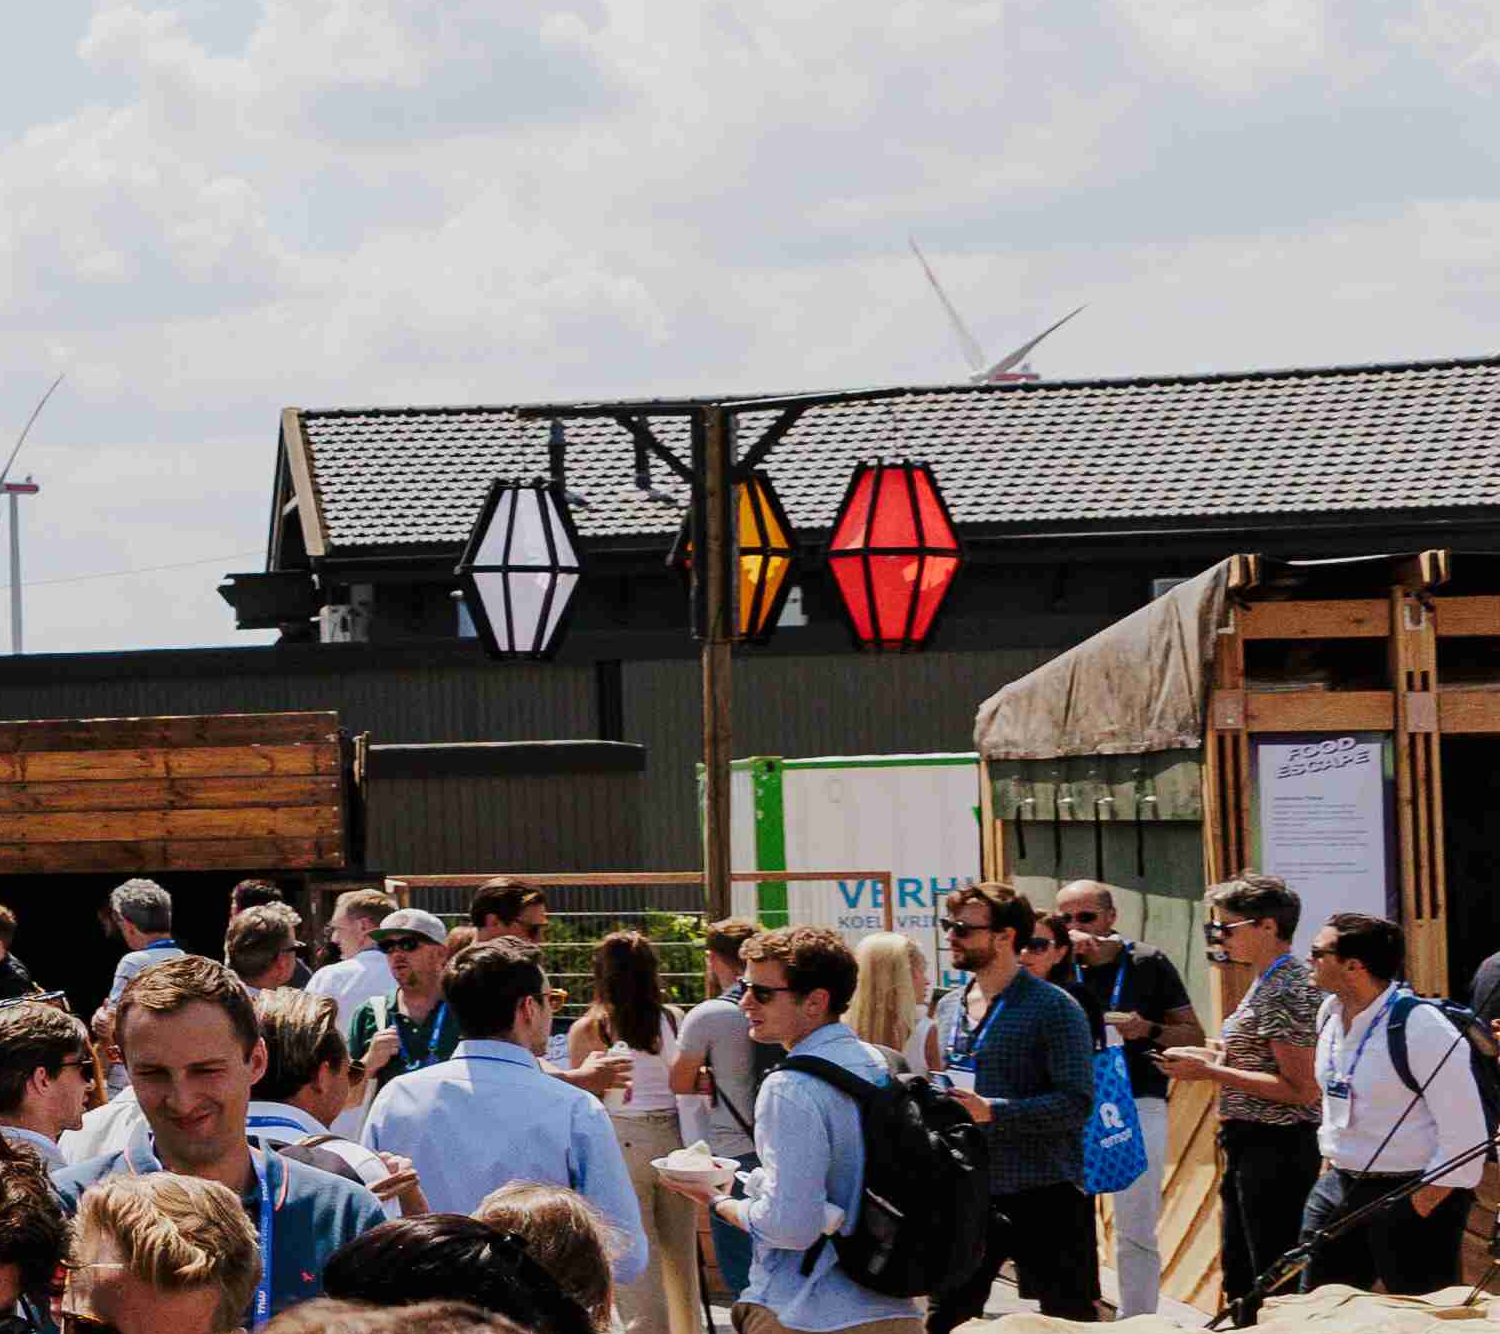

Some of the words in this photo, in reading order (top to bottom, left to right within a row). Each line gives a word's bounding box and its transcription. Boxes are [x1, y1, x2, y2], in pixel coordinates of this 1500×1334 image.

[1288, 736, 1357, 762] FOOD
[1277, 750, 1371, 779] ESCAPE
[838, 877, 973, 908] VERH
